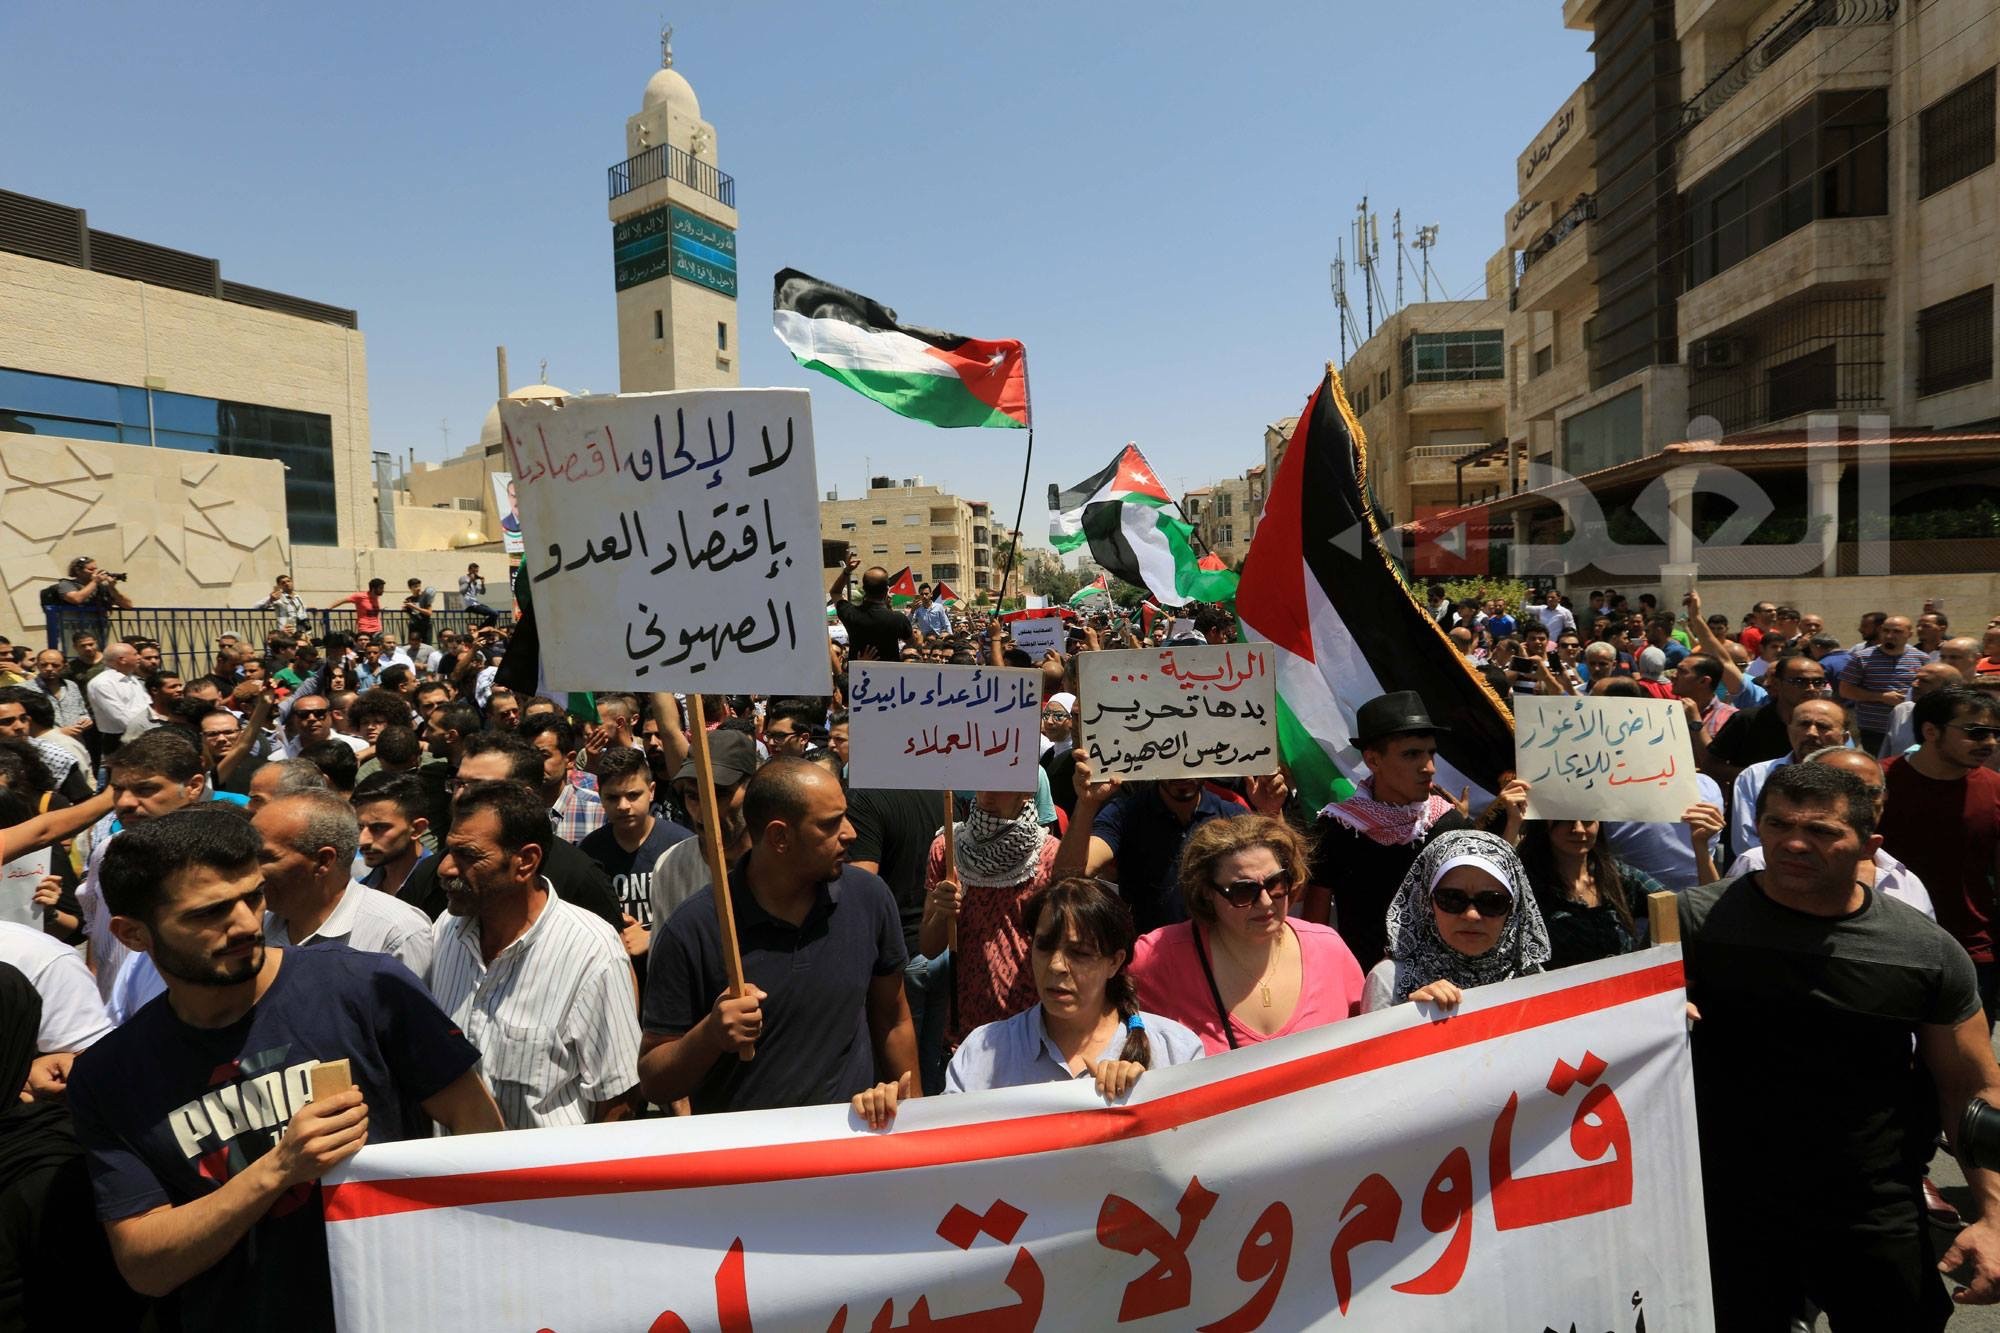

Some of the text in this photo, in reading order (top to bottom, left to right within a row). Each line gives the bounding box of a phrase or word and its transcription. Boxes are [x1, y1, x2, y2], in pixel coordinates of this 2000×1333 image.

[748, 416, 794, 477] لا
[533, 498, 793, 583] بإقتصاد العدو
[625, 598, 796, 677] الصهيوني
[920, 669, 998, 708] الأعداء
[1159, 650, 1265, 692] الرابية
[994, 677, 1038, 714] غاز
[1083, 695, 1268, 732] بدها تحرير
[904, 720, 1020, 766] إلا العملاء
[1520, 699, 1677, 755] أراضي الأغوار
[1086, 731, 1189, 774] الصهيونية
[1608, 754, 1676, 788] ليست
[1331, 1049, 1634, 1318] قاوم
[1096, 1174, 1295, 1333] ولا
